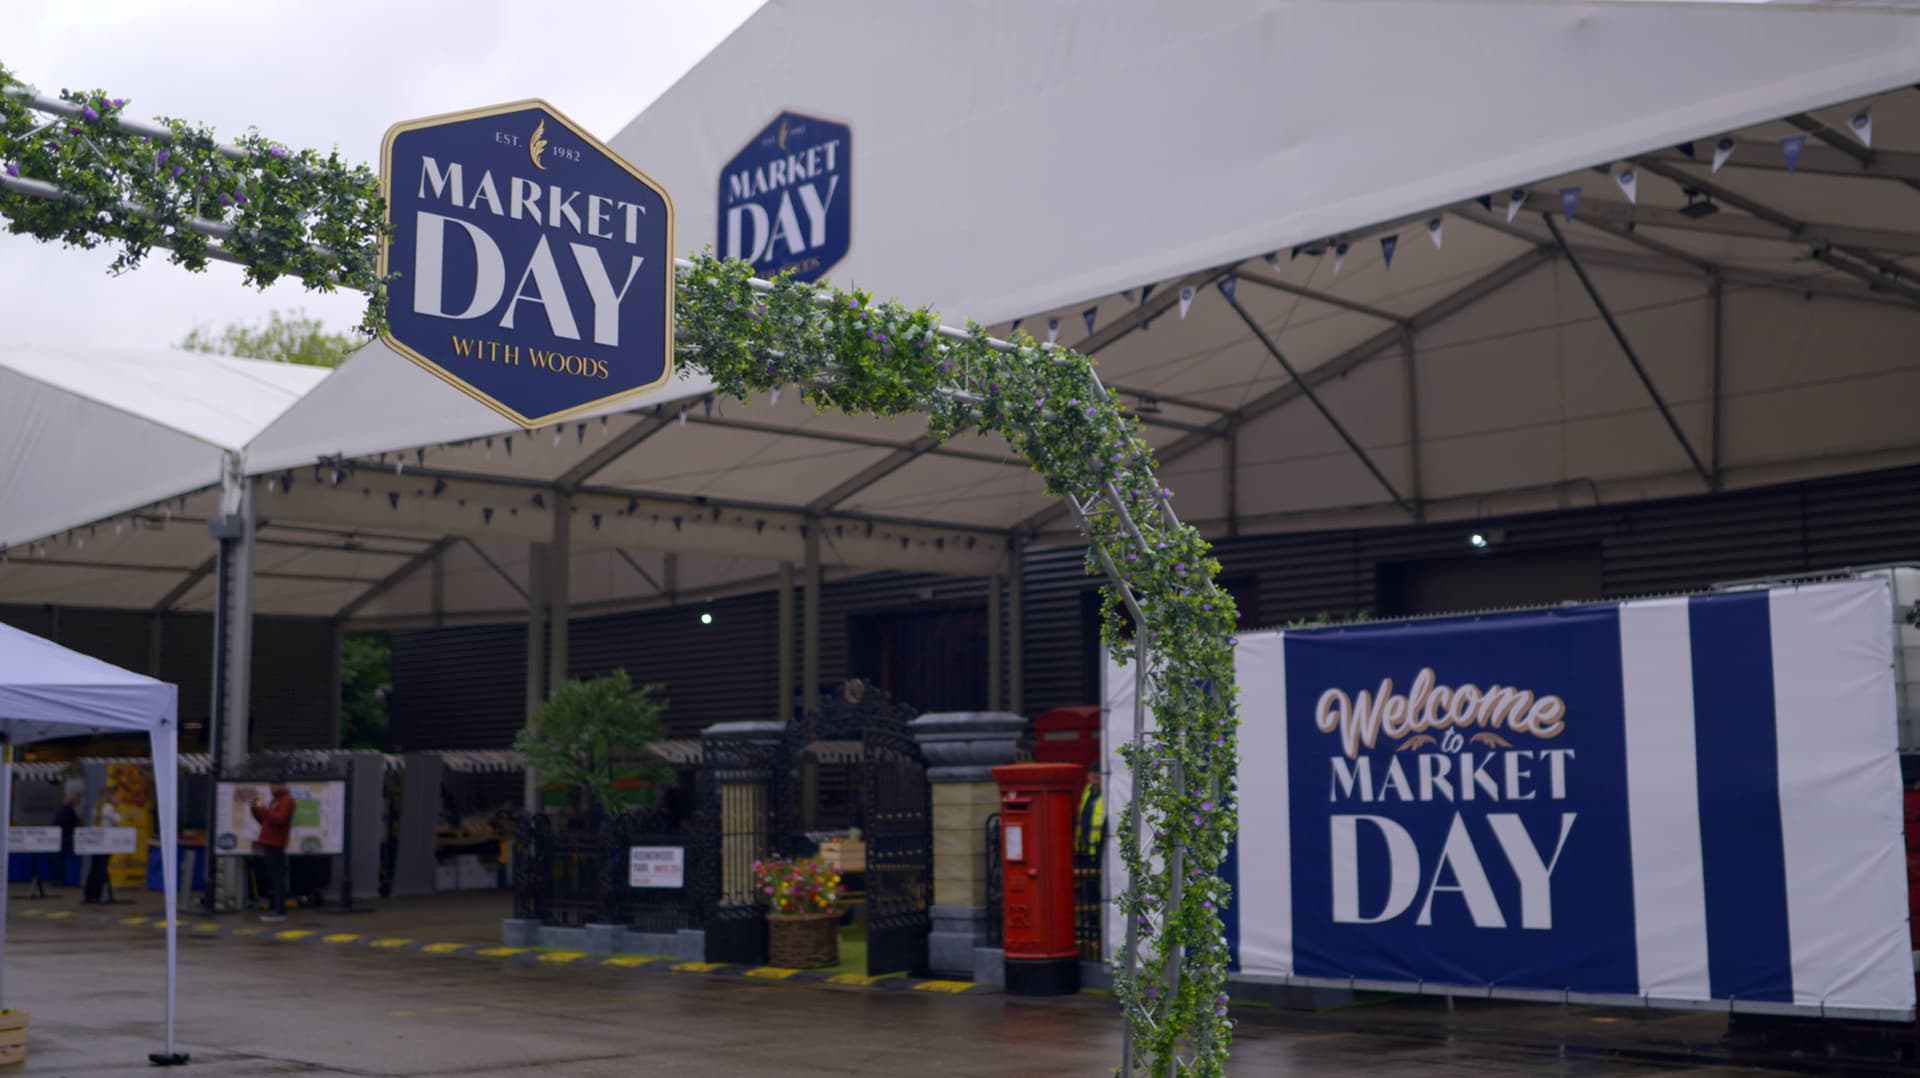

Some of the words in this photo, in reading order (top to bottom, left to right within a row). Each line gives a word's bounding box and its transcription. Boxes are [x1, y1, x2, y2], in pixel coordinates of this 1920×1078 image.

[495, 131, 522, 148] EST.
[553, 145, 581, 162] 1982
[728, 139, 840, 204] MARKET
[418, 155, 646, 245] MARKET
[727, 175, 839, 265] DAY
[413, 210, 645, 347] DAY
[452, 335, 520, 366] WITH
[529, 347, 609, 380] WOODS
[1315, 667, 1566, 760] Welcome
[1440, 726, 1465, 754] to
[1330, 748, 1576, 803] MARKET
[1330, 810, 1578, 930] DAY
